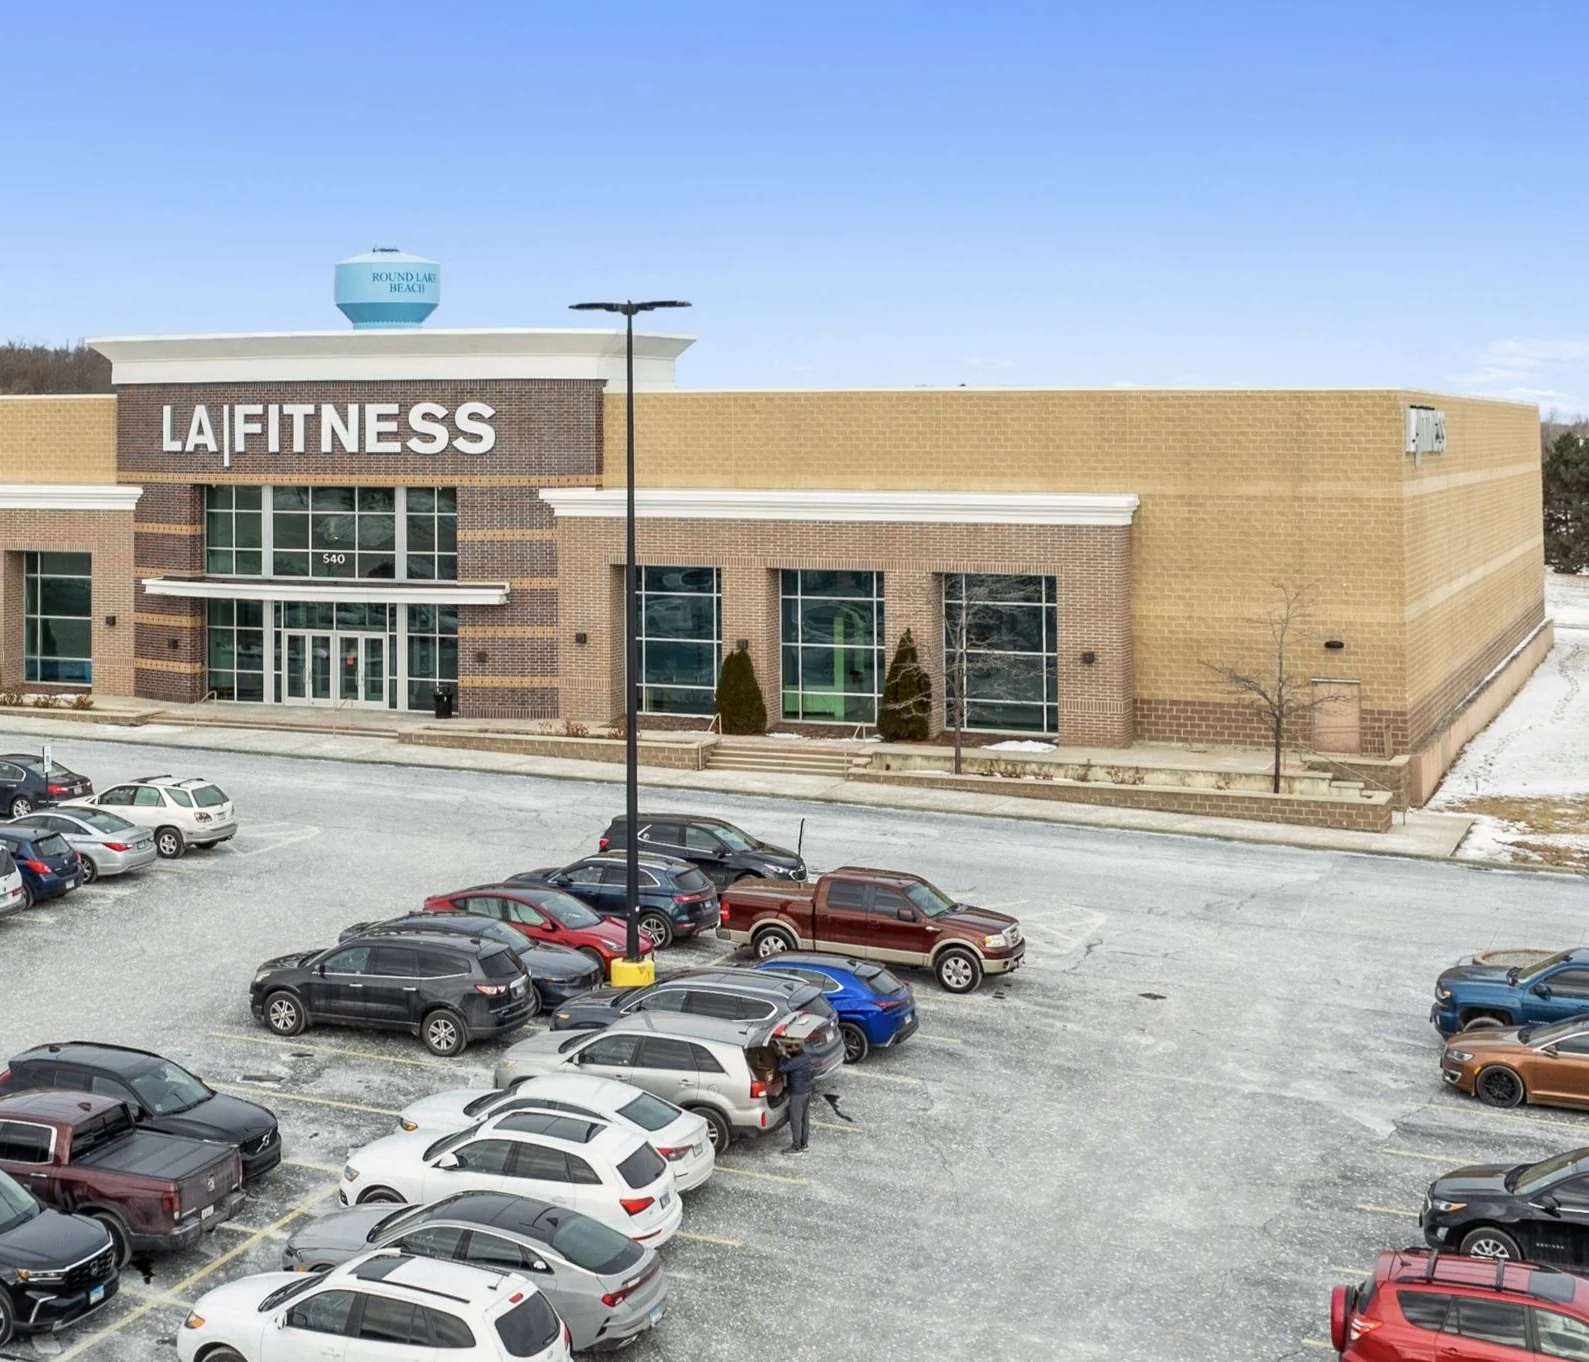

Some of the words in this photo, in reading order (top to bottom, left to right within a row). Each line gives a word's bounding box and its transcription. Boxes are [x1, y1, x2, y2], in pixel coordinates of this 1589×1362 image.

[372, 271, 413, 283] ROUND
[389, 282, 425, 294] BEACH
[322, 553, 345, 564] 540
